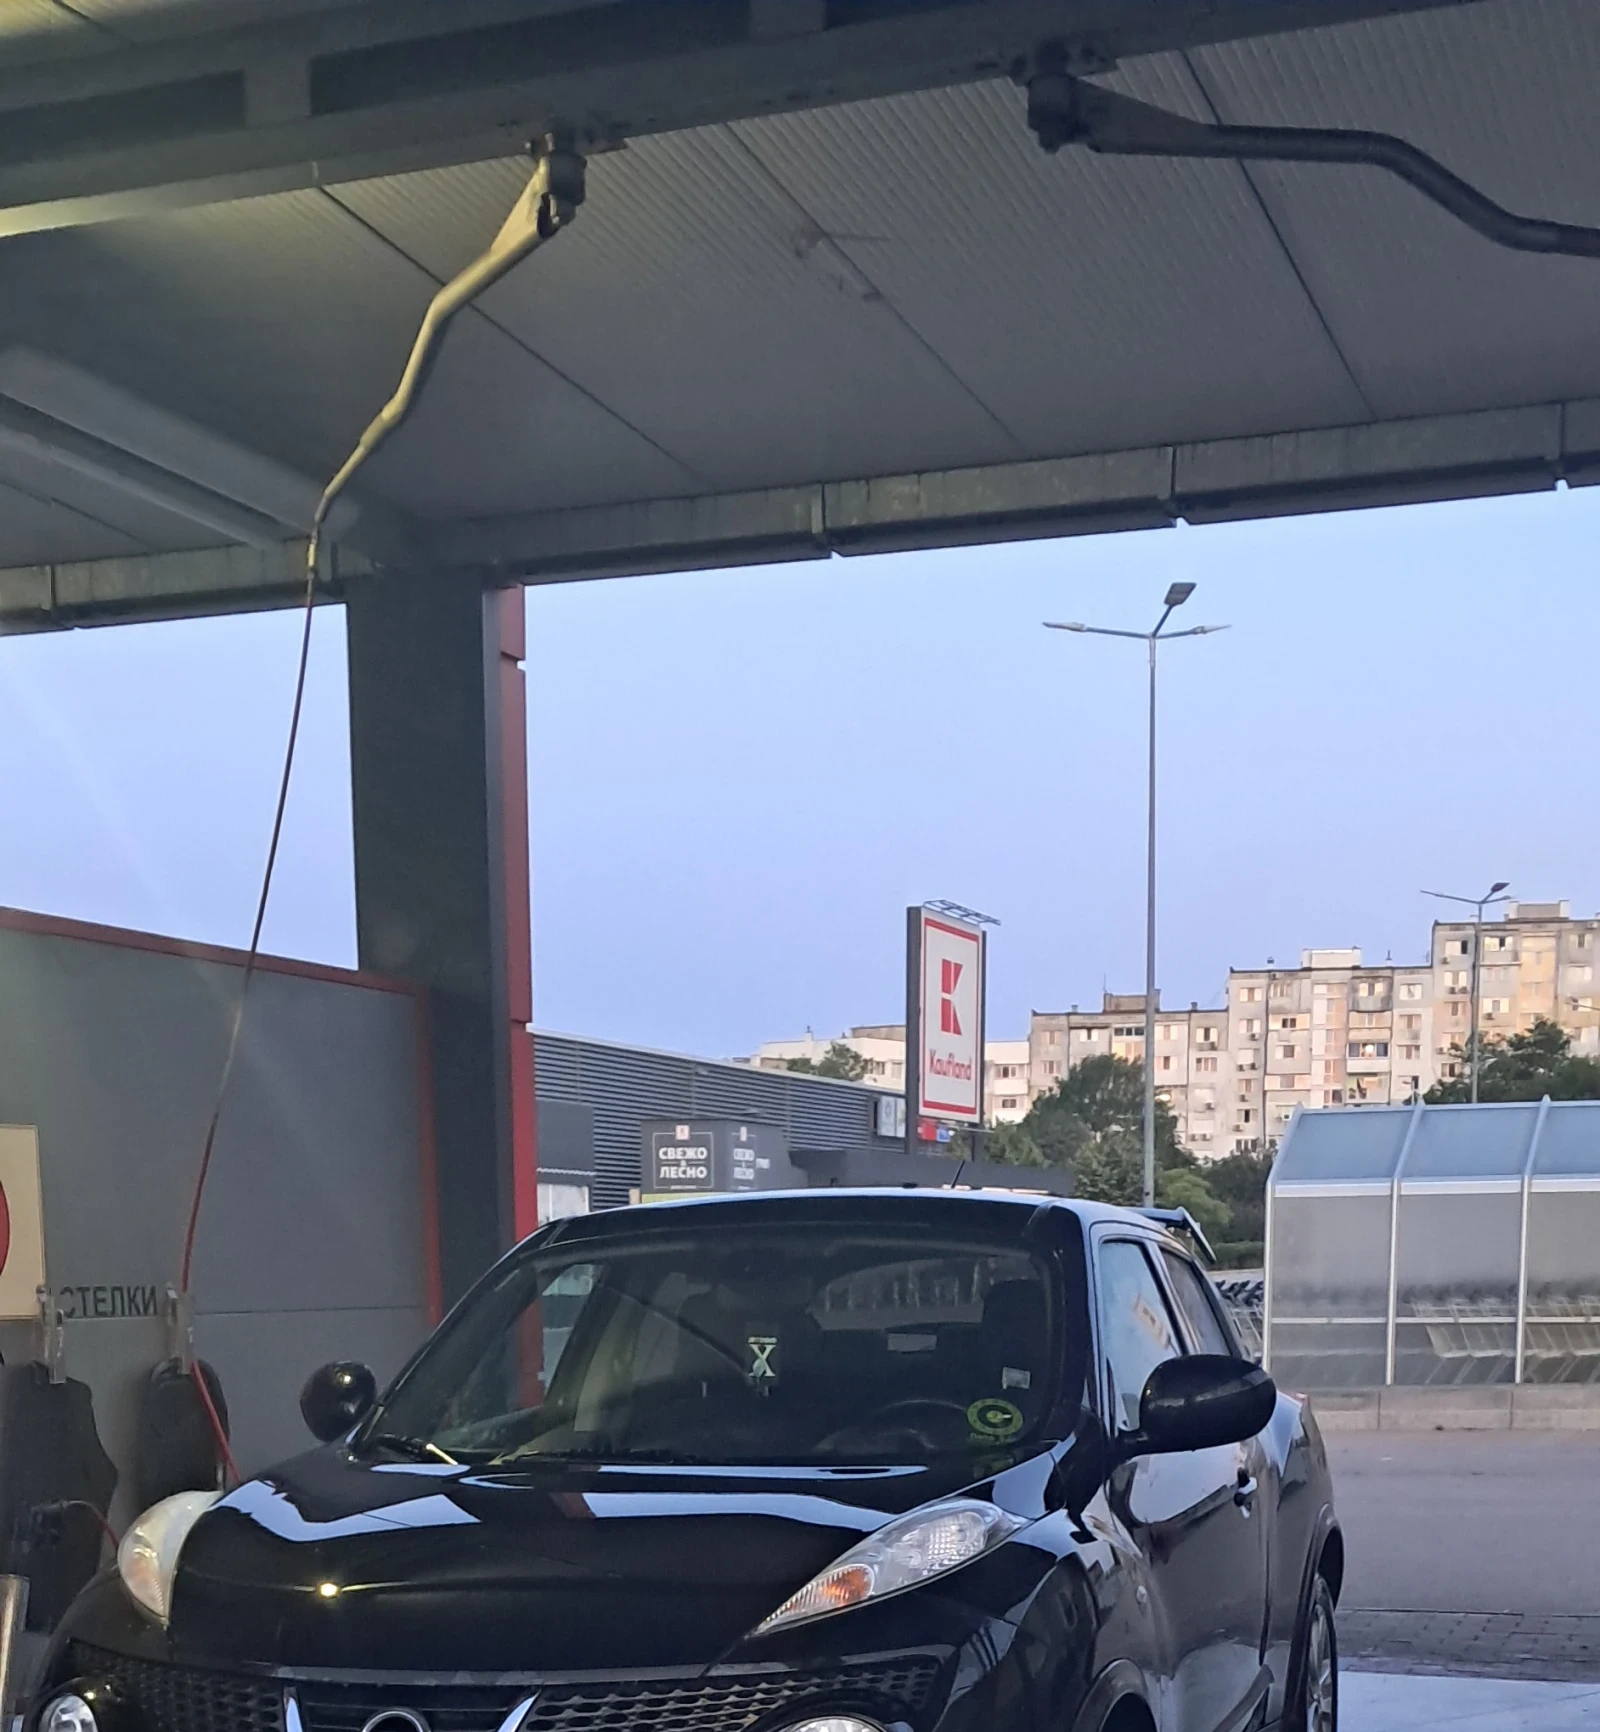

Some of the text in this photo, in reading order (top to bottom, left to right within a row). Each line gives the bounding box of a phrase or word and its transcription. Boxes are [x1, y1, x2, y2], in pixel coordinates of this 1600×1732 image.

[929, 1049, 972, 1081] Kaufland
[658, 1146, 708, 1160] СВЕЖО
[658, 1166, 708, 1179] ЛЕСНО
[49, 1285, 158, 1319] СТЕЛКИ
